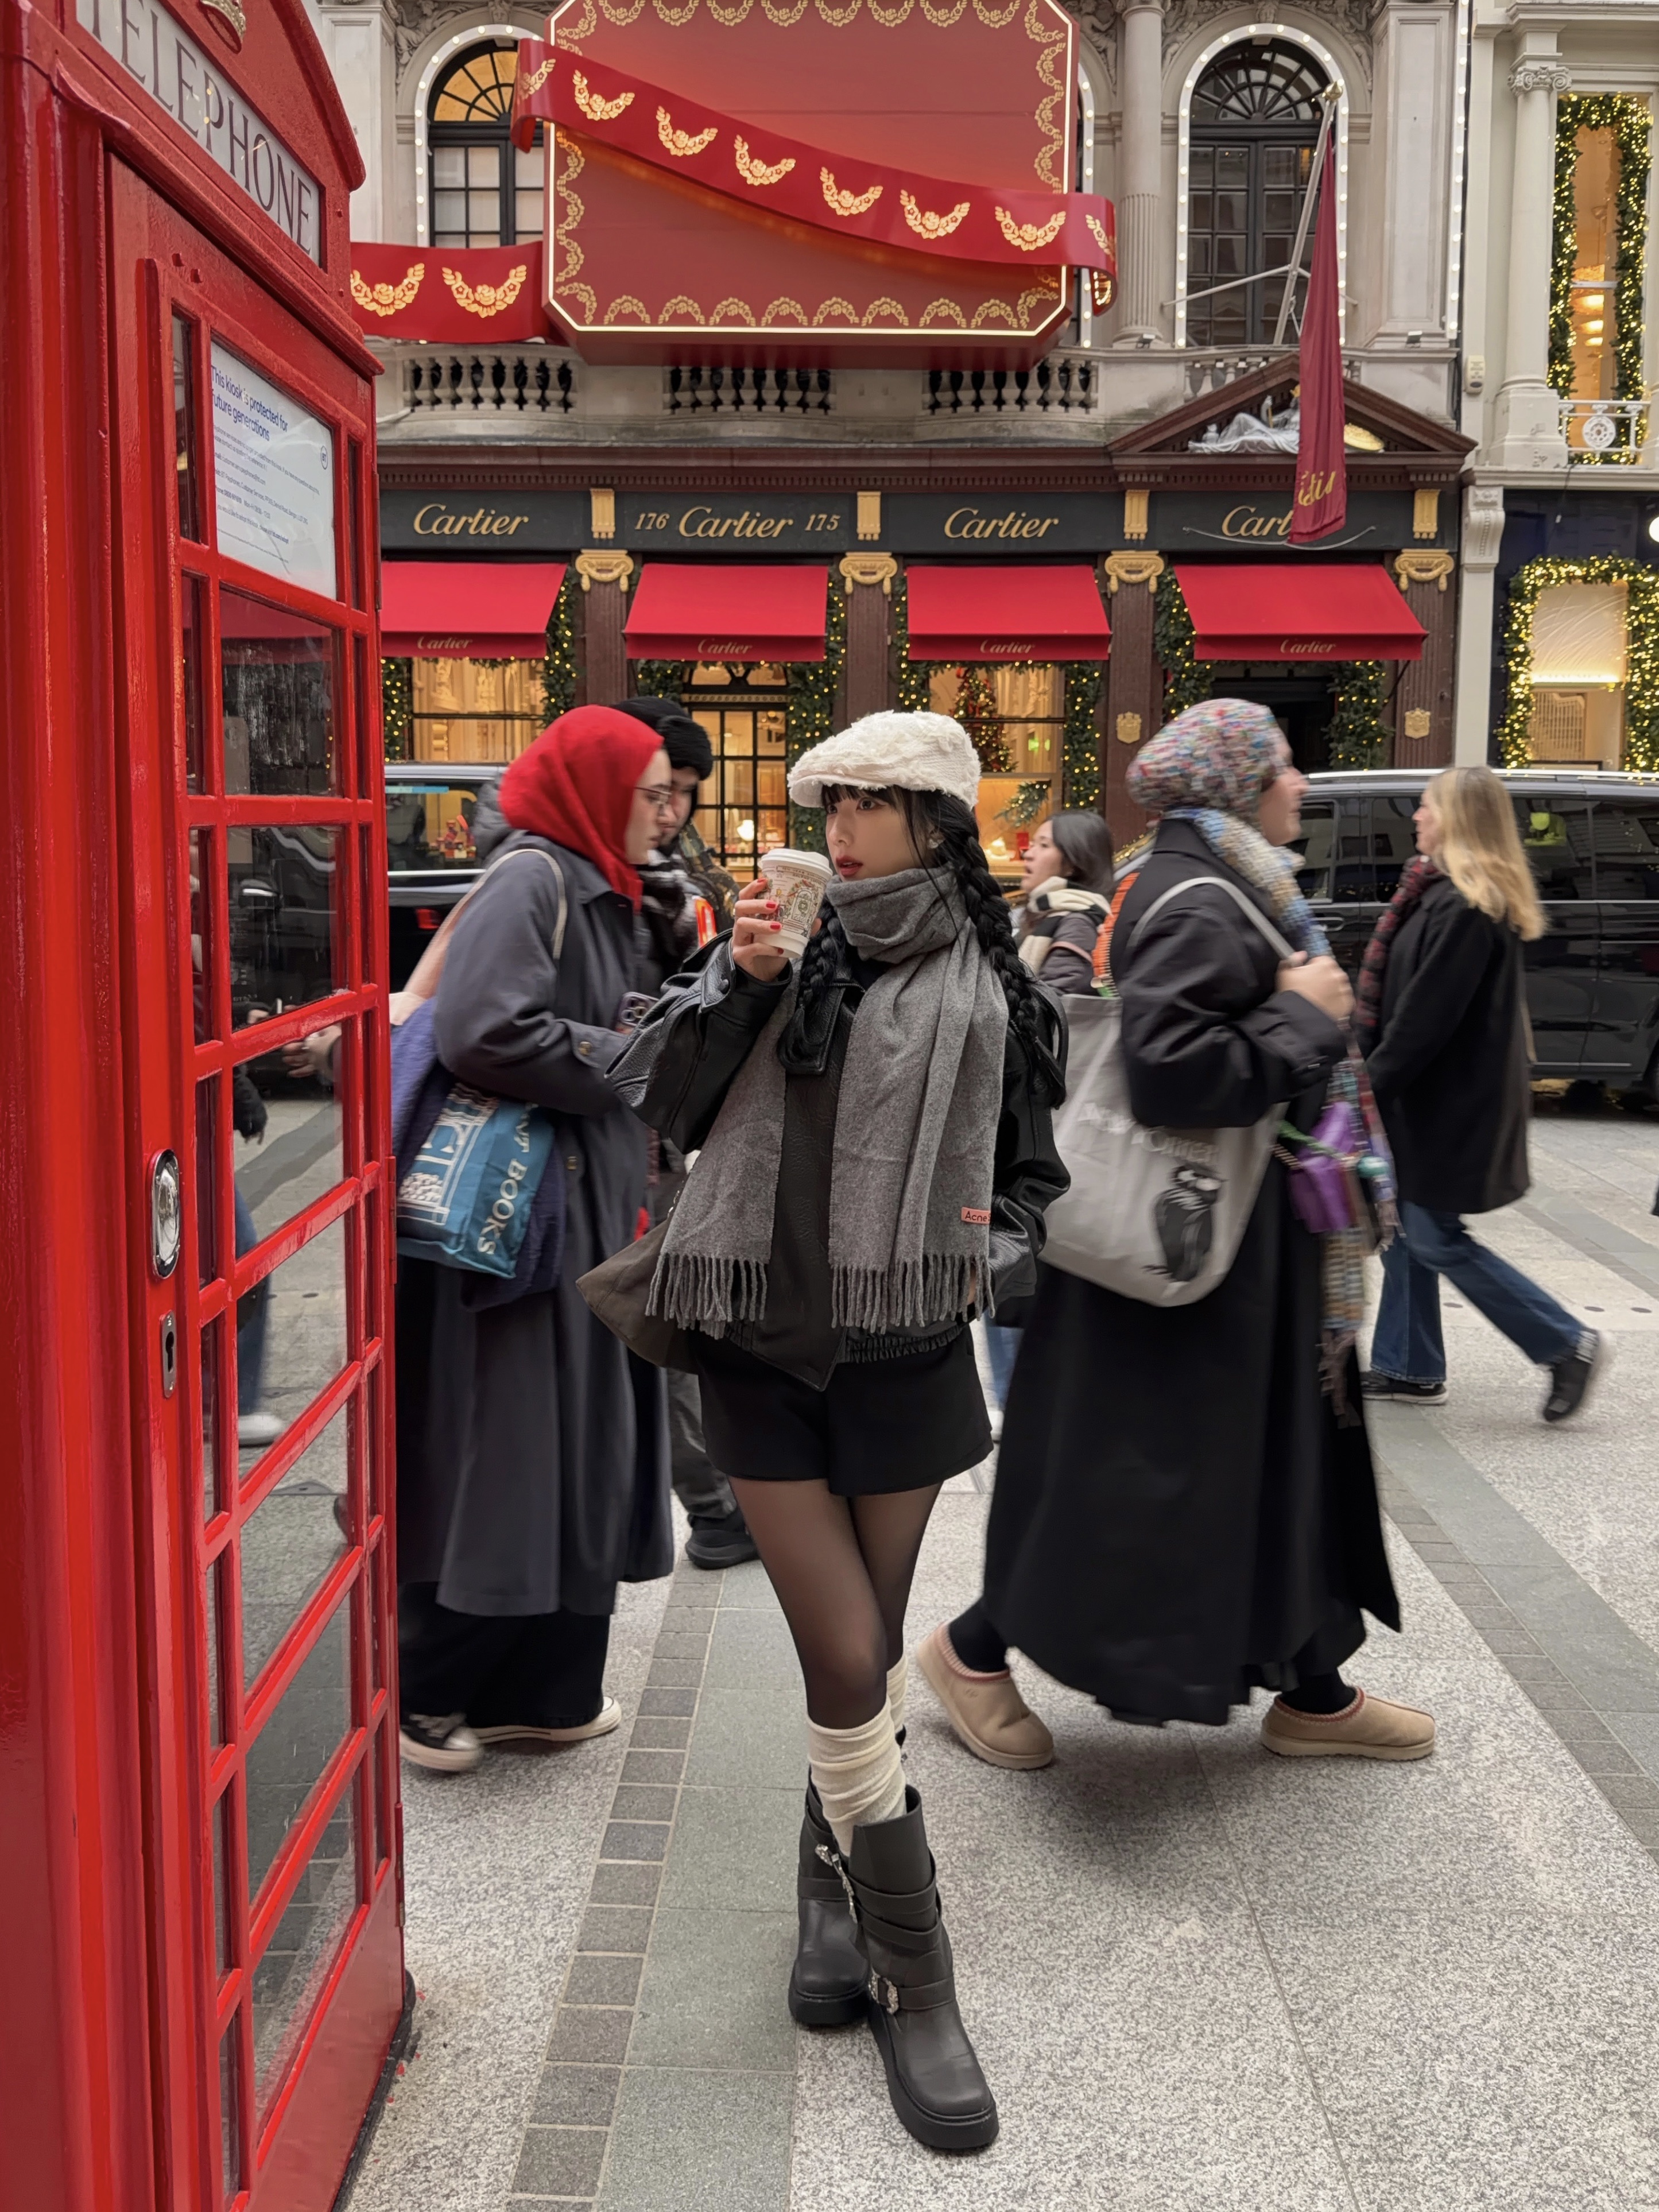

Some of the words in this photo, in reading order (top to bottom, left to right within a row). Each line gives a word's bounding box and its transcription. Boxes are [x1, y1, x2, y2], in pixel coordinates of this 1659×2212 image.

[211, 365, 224, 388] This
[225, 375, 242, 401] kiosk
[243, 388, 249, 405] is
[250, 397, 279, 427] protected
[280, 414, 288, 432] for
[233, 408, 270, 441] generations
[413, 503, 529, 535] Cartier
[634, 513, 670, 530] 176
[679, 506, 794, 538] Cartier
[804, 514, 841, 531] 175
[944, 507, 1060, 539] Cartier
[1222, 505, 1294, 537] Cart
[417, 636, 473, 650] Cartier
[697, 638, 753, 654] Cartier
[980, 638, 1036, 654] Cartier
[1280, 638, 1336, 654] Cartier
[477, 1158, 528, 1256] BOOKS
[965, 1211, 987, 1222] Acne
